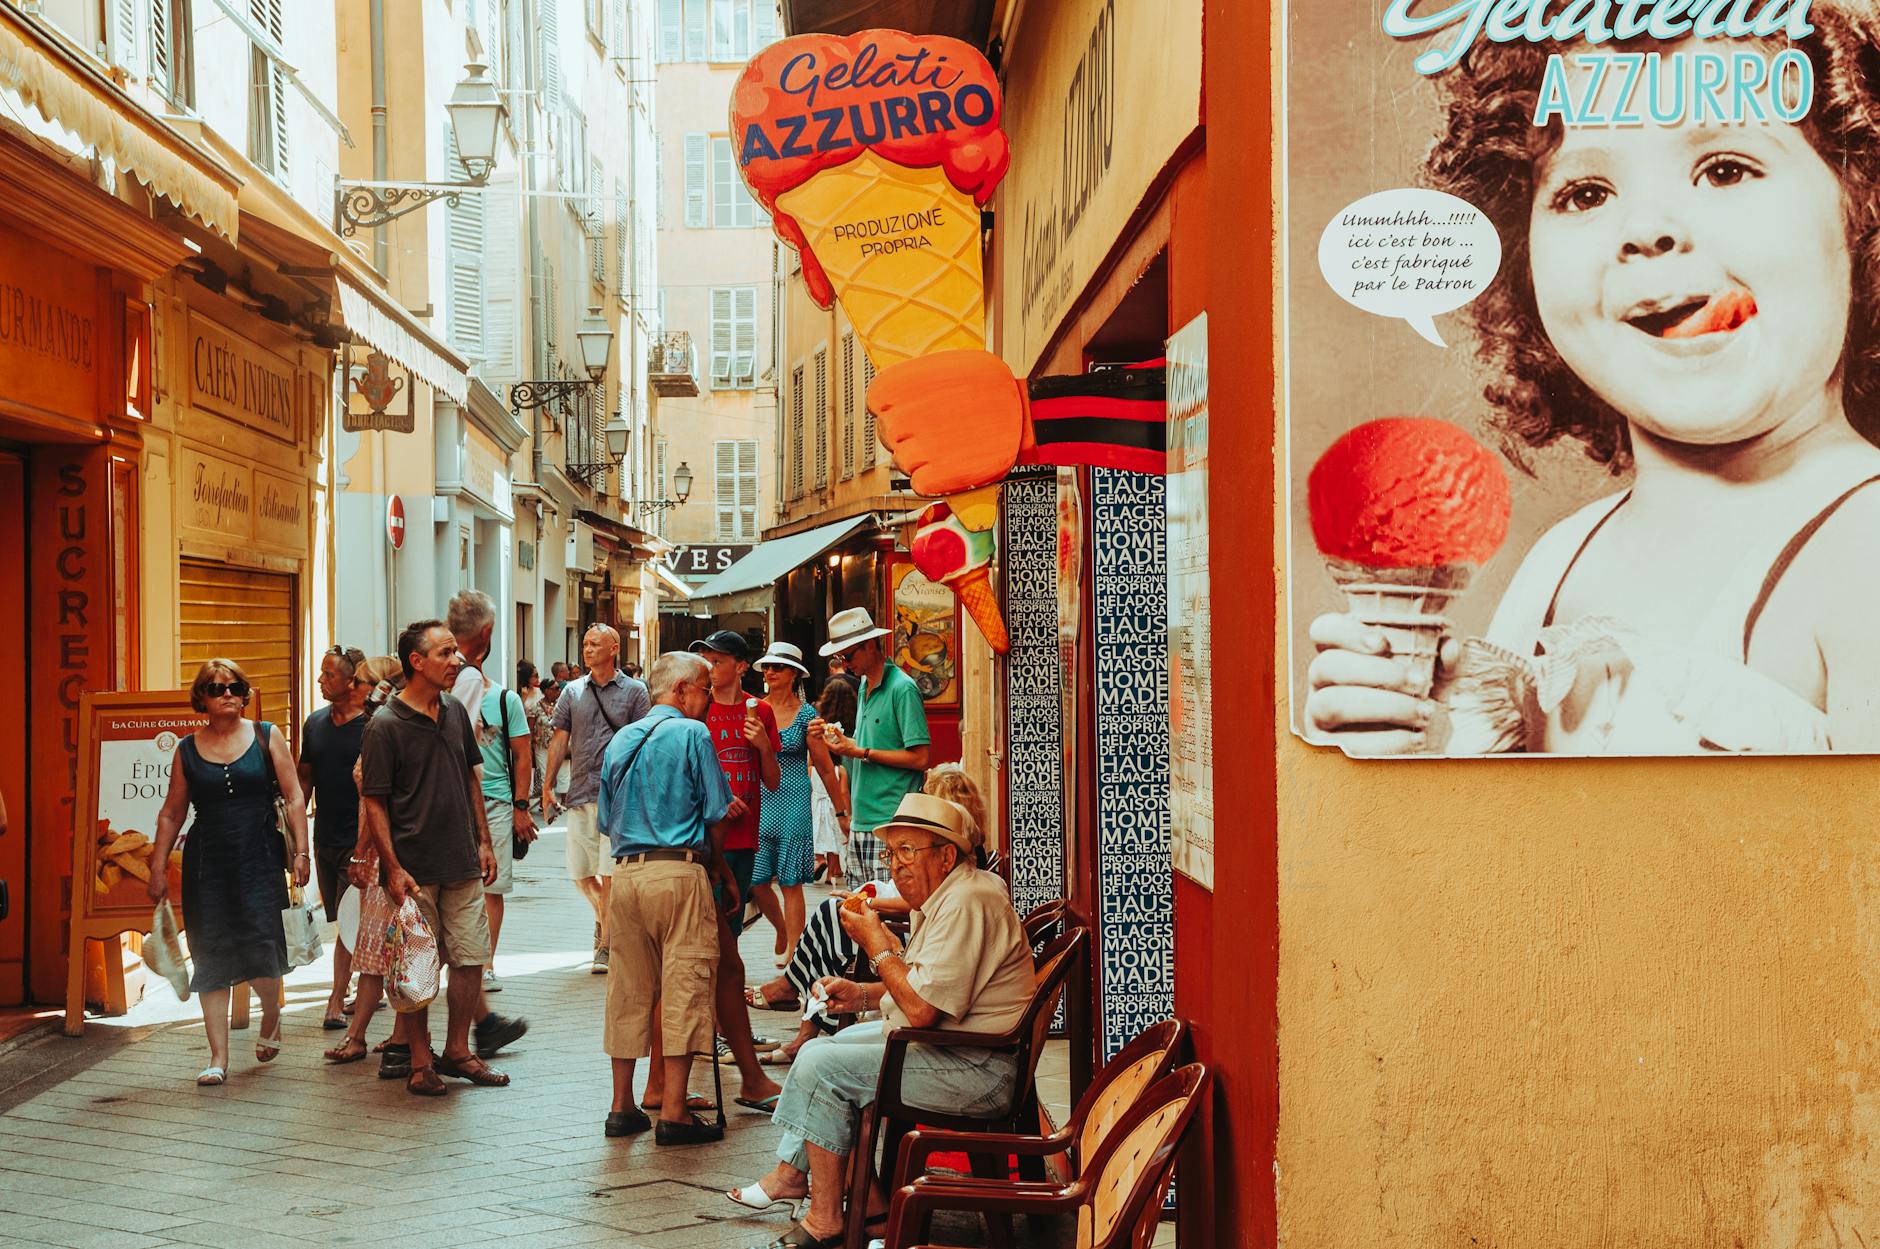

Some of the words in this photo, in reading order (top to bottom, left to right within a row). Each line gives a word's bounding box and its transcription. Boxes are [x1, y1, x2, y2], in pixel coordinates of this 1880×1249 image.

[779, 43, 964, 108] Gelati
[1533, 49, 1815, 127] AZZURRO
[741, 84, 994, 166] AZZURRO
[1060, 0, 1114, 252] AZZURRO
[833, 208, 946, 242] PRODUZIONE
[1348, 233, 1374, 248] ici
[1378, 234, 1417, 248] c'est
[1422, 232, 1455, 247] bon
[860, 235, 933, 257] PROPRIA
[1351, 256, 1391, 269] c'est
[1390, 253, 1473, 277] fabriqué
[1352, 279, 1386, 298] par
[1391, 275, 1409, 290] le
[1415, 277, 1477, 290] Patron
[194, 336, 237, 406] CAFÉS
[242, 352, 291, 429] INDIENS
[1095, 467, 1110, 477] DE
[1008, 485, 1055, 496] MADE
[1095, 476, 1164, 494] HAUS
[1095, 494, 1164, 504] GEMACHT
[1008, 508, 1055, 517] PROPRIA
[1095, 505, 1164, 520] GLACES
[1008, 516, 1056, 525] HELADOS
[1096, 519, 1164, 532] MAISON
[1008, 524, 1019, 532] DE
[1022, 524, 1032, 532] LA
[1009, 532, 1056, 543] HAUS
[1096, 532, 1165, 549] HOME
[1009, 551, 1056, 561] GLACES
[1096, 548, 1165, 565] MADE
[1009, 560, 1056, 569] MAISON
[1096, 565, 1116, 574] ICE
[1119, 564, 1165, 574] CREAM
[1009, 570, 1057, 581] HOME
[1096, 575, 1165, 584] PRODUZIONE
[1009, 581, 1057, 592] MADE
[1097, 583, 1165, 594] PROPRIA
[1097, 594, 1166, 606] HELADOS
[1009, 604, 1057, 612] PROPRIA
[1097, 606, 1112, 616] DE
[1116, 606, 1131, 616] LA
[1134, 606, 1166, 615] CASA
[1010, 612, 1057, 621] HELADOS
[1010, 620, 1021, 628] DE
[1098, 616, 1167, 633] HAUS
[1010, 627, 1057, 639] HAUS
[1098, 633, 1167, 644] GEMACHT
[1010, 638, 1057, 646] GEMACHT
[1010, 647, 1058, 657] GLACES
[1098, 645, 1167, 659] GLACES
[1010, 656, 1058, 665] MAISON
[1099, 658, 1167, 671] MAISON
[1010, 665, 1058, 677] HOME
[1011, 676, 1058, 688] MADE
[1098, 671, 1168, 688] HOME
[1099, 688, 1168, 704] MADE
[1011, 700, 1058, 708] PROPRIA
[1099, 704, 1119, 714] ICE
[1122, 704, 1168, 714] CREAM
[1011, 708, 1059, 716] HELADOS
[1011, 716, 1022, 724] DE
[1099, 714, 1168, 723] PRODUZIONE
[1011, 723, 1059, 735] HAUS
[1100, 722, 1168, 734] PROPRIA
[1012, 734, 1058, 742] GEMACHT
[1100, 734, 1169, 746] HELADOS
[1012, 743, 1059, 753] GLACES
[1100, 746, 1115, 756] DE
[1119, 746, 1134, 755] LA
[1137, 745, 1169, 755] CASA
[1012, 752, 1059, 761] MAISON
[1012, 761, 1059, 773] HOME
[1101, 756, 1170, 773] HAUS
[1012, 772, 1059, 784] MADE
[1101, 772, 1170, 783] GEMACHT
[1101, 784, 1170, 798] GLACES
[1012, 796, 1059, 804] PROPRIA
[1102, 798, 1170, 811] MAISON
[1012, 804, 1060, 812] HELADOS
[1038, 811, 1060, 819] CASA
[1101, 811, 1171, 828] HOME
[1013, 819, 1060, 831] HAUS
[1013, 830, 1060, 838] GEMACHT
[1102, 827, 1171, 844] MADE
[1013, 838, 1060, 849] GLACES
[1102, 844, 1122, 854] ICE
[1125, 843, 1171, 853] CREAM
[1013, 847, 1060, 857] MAISON
[1013, 857, 1061, 869] HOME
[1102, 854, 1171, 862] PRODUZIONE
[1103, 862, 1171, 873] PROPRIA
[1013, 868, 1061, 880] MADE
[1103, 874, 1172, 885] HELADOS
[1103, 886, 1118, 895] DE
[1122, 885, 1137, 895] LA
[1140, 885, 1172, 894] CASA
[1013, 892, 1061, 900] PROPRIA
[1104, 895, 1172, 912] HAUS
[1104, 912, 1172, 922] GEMACHT
[1104, 924, 1173, 938] GLACES
[1105, 937, 1173, 950] MAISON
[1104, 950, 1174, 967] HOME
[1105, 967, 1174, 983] MADE
[1105, 984, 1125, 993] ICE
[1128, 983, 1174, 993] CREAM
[1105, 994, 1174, 1002] PRODUZIONE
[1106, 1001, 1174, 1013] PROPRIA
[1106, 1025, 1121, 1035] DE
[1125, 1025, 1140, 1034] LA
